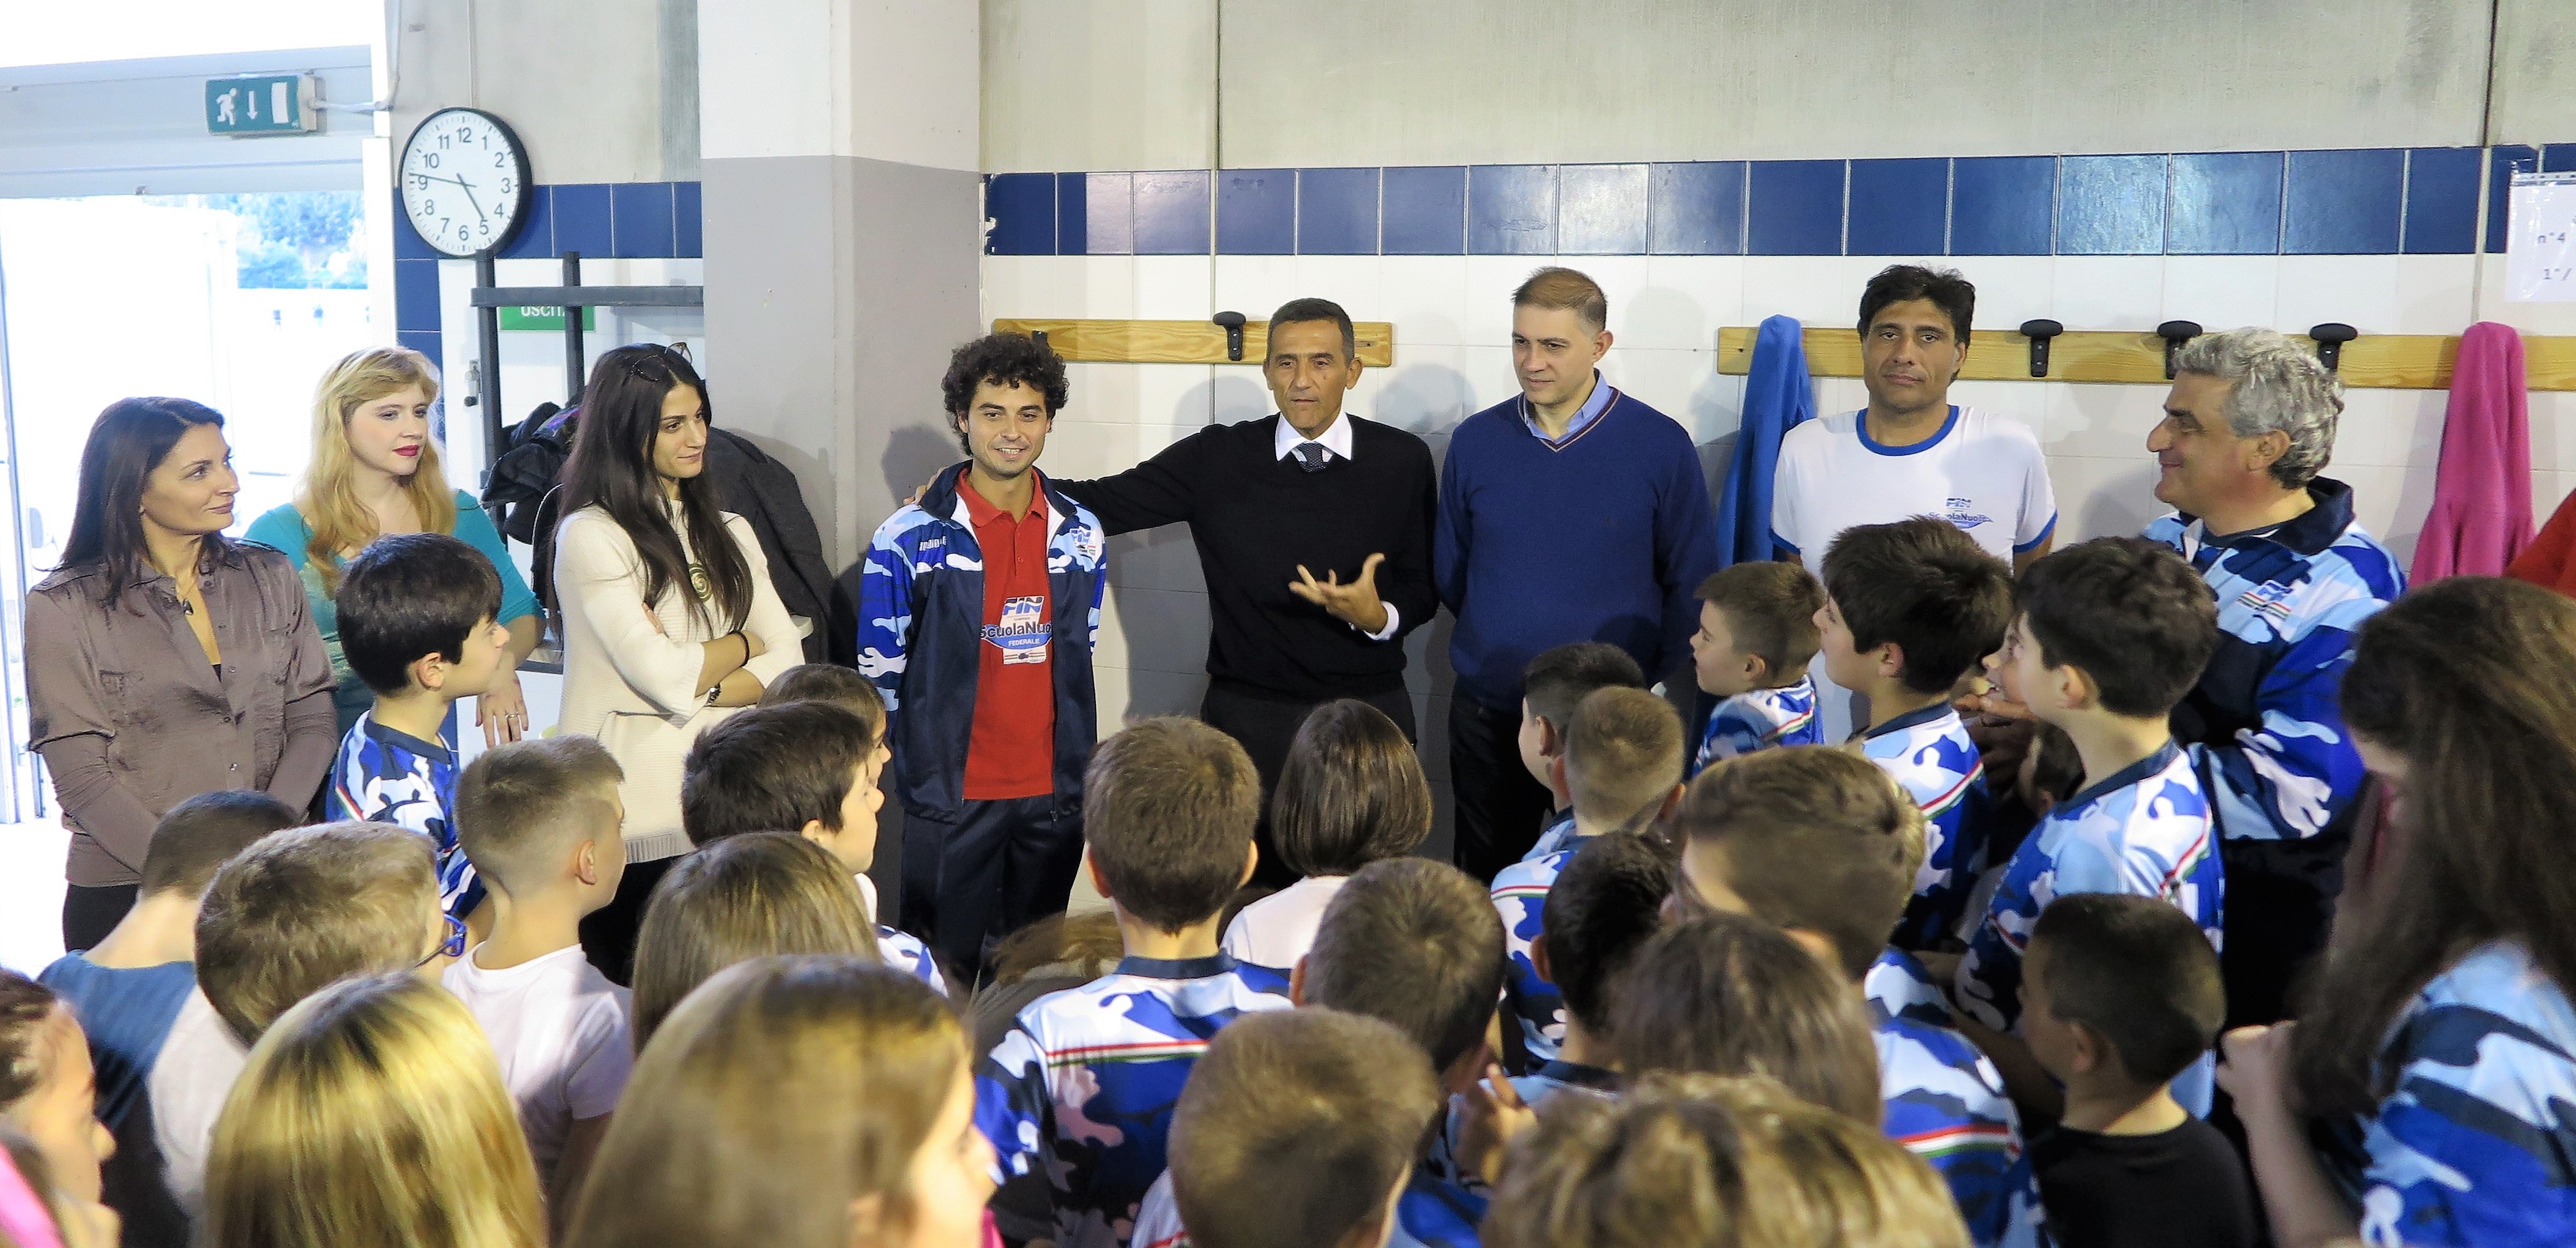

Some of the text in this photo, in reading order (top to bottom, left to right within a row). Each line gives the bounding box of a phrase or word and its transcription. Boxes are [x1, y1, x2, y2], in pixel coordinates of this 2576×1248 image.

[437, 134, 450, 149] 11
[456, 127, 472, 143] 12
[481, 135, 488, 150] 1
[423, 153, 440, 168] 10
[494, 152, 504, 168] 2
[418, 175, 428, 190] 9
[501, 177, 511, 193] 3
[424, 200, 434, 215] 8
[494, 203, 504, 218] 4
[440, 218, 450, 233] 7
[459, 225, 469, 241] 6
[479, 219, 489, 234] 5
[1002, 596, 1043, 616] FIN
[980, 621, 1052, 638] ScuolaNuo
[1008, 638, 1040, 647] FEDERALE
